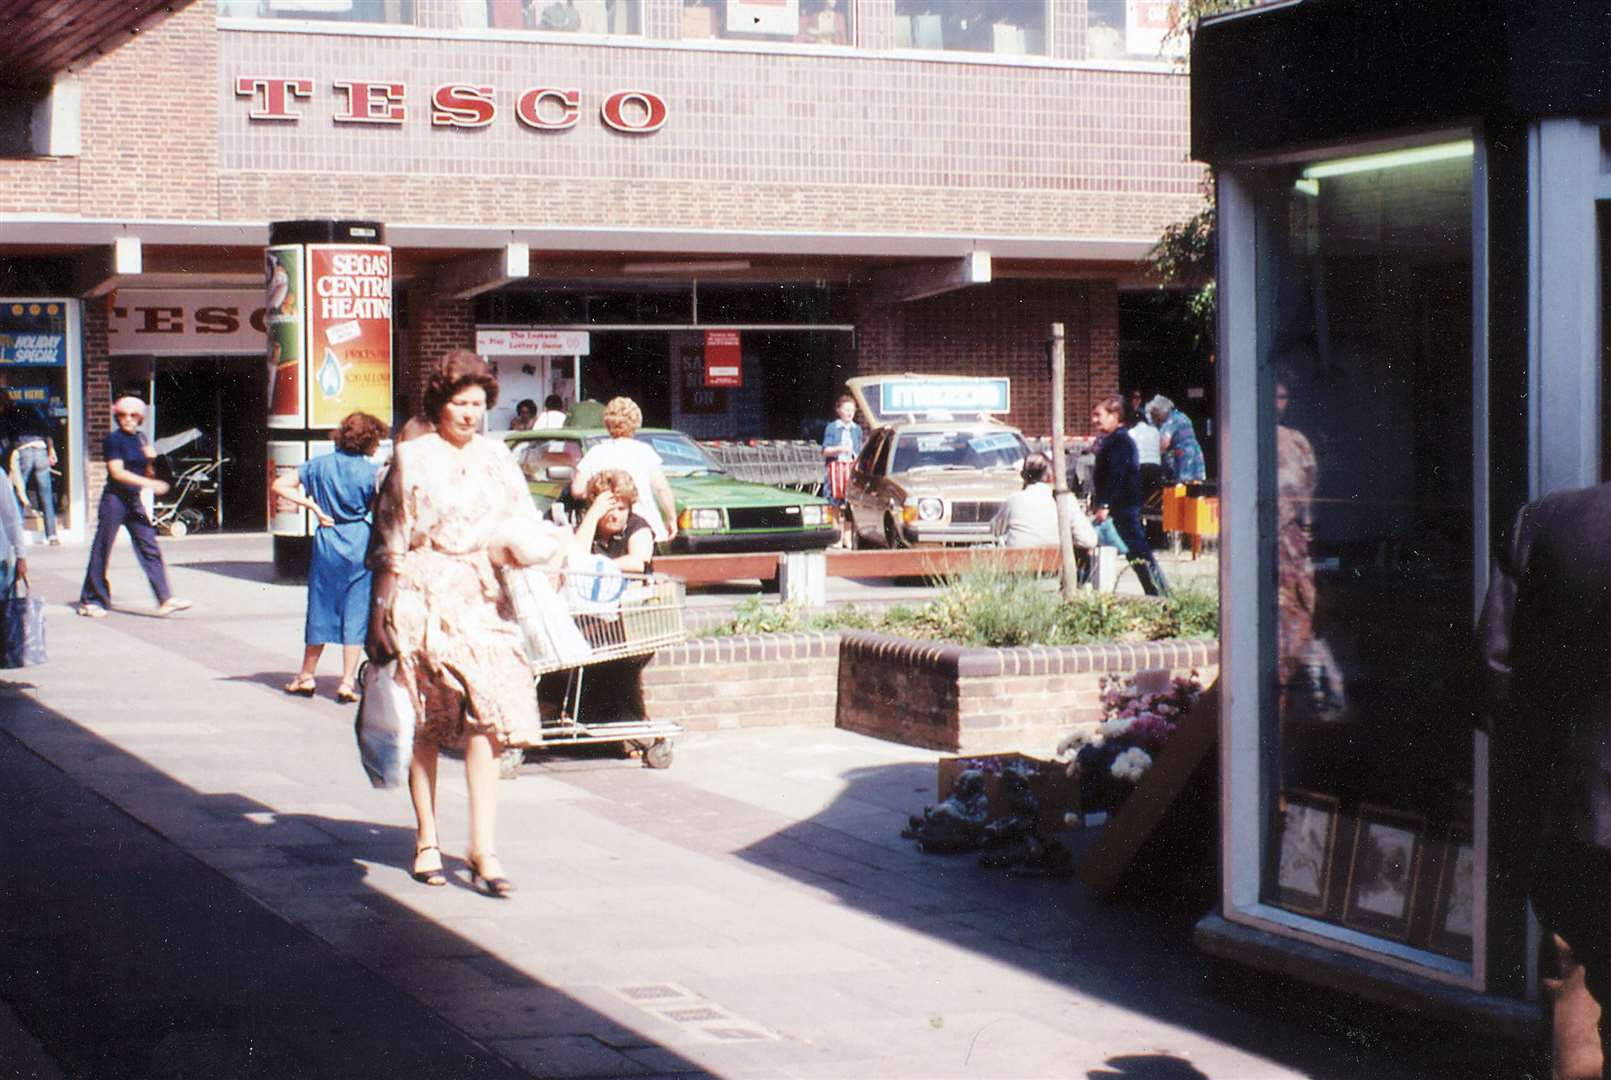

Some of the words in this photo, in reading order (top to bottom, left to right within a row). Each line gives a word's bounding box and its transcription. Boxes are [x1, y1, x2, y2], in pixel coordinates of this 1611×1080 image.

[235, 76, 669, 132] TESCO
[332, 254, 387, 275] SEGAS
[15, 335, 62, 349] HOLIDAY
[14, 348, 58, 363] SPECIAL
